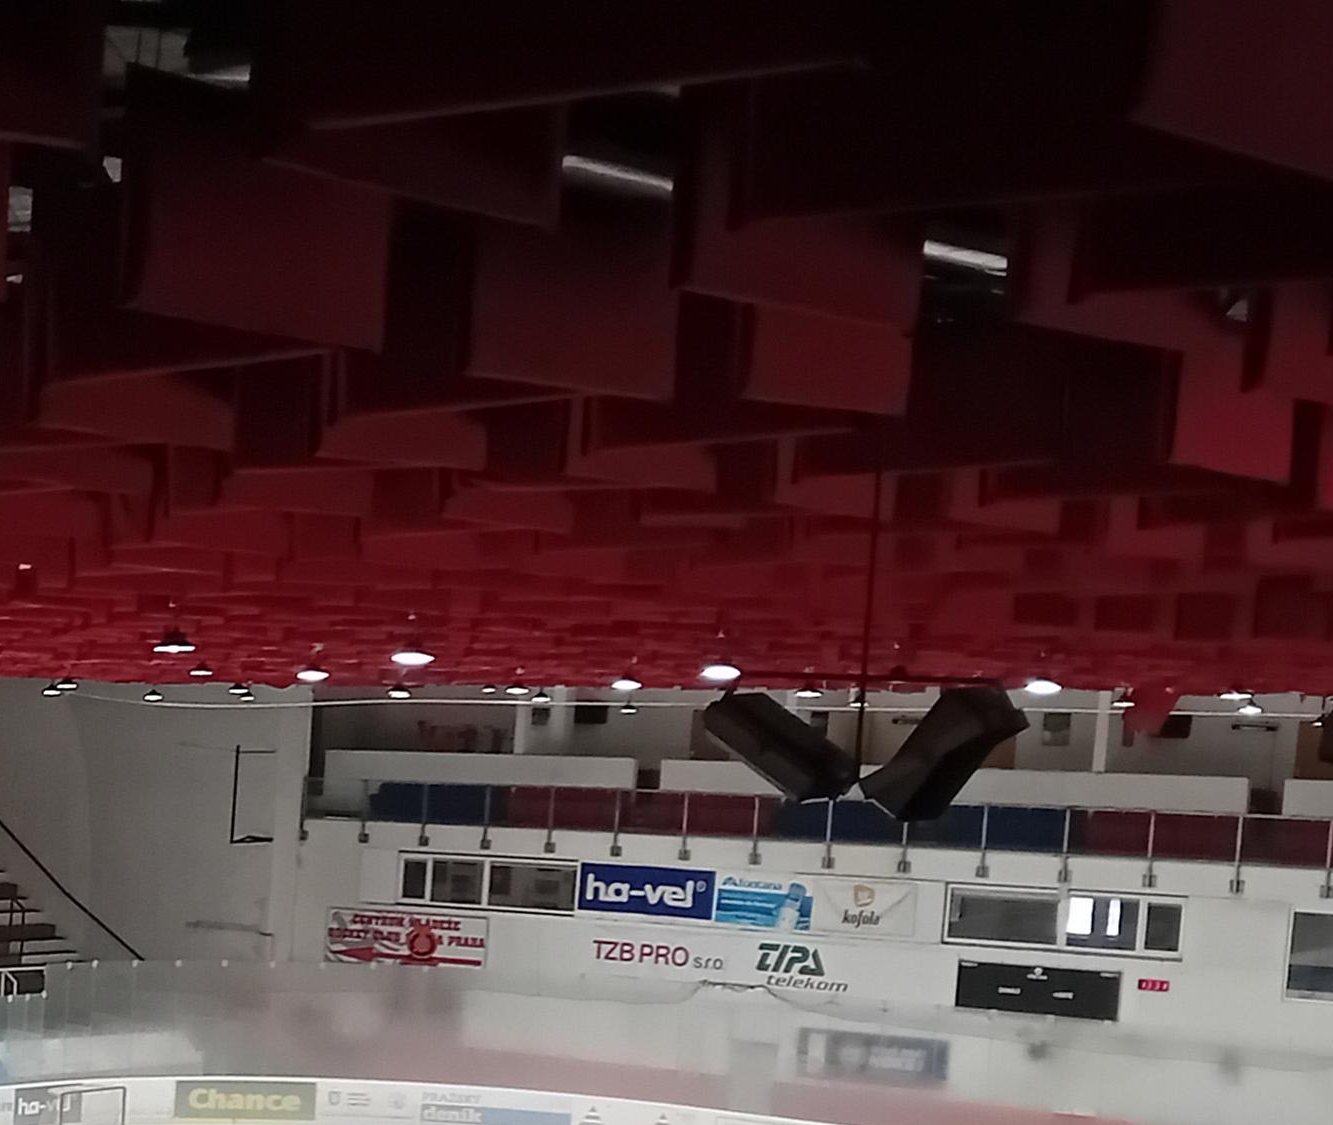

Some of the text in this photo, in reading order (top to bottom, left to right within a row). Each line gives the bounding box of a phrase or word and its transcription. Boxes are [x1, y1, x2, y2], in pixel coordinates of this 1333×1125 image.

[585, 873, 694, 909] ha-vel
[840, 909, 882, 929] kofola
[592, 939, 635, 962] TZB
[638, 944, 690, 967] PRO
[755, 943, 826, 977] TIPA
[765, 974, 849, 993] telekom
[188, 1087, 302, 1112] Chance
